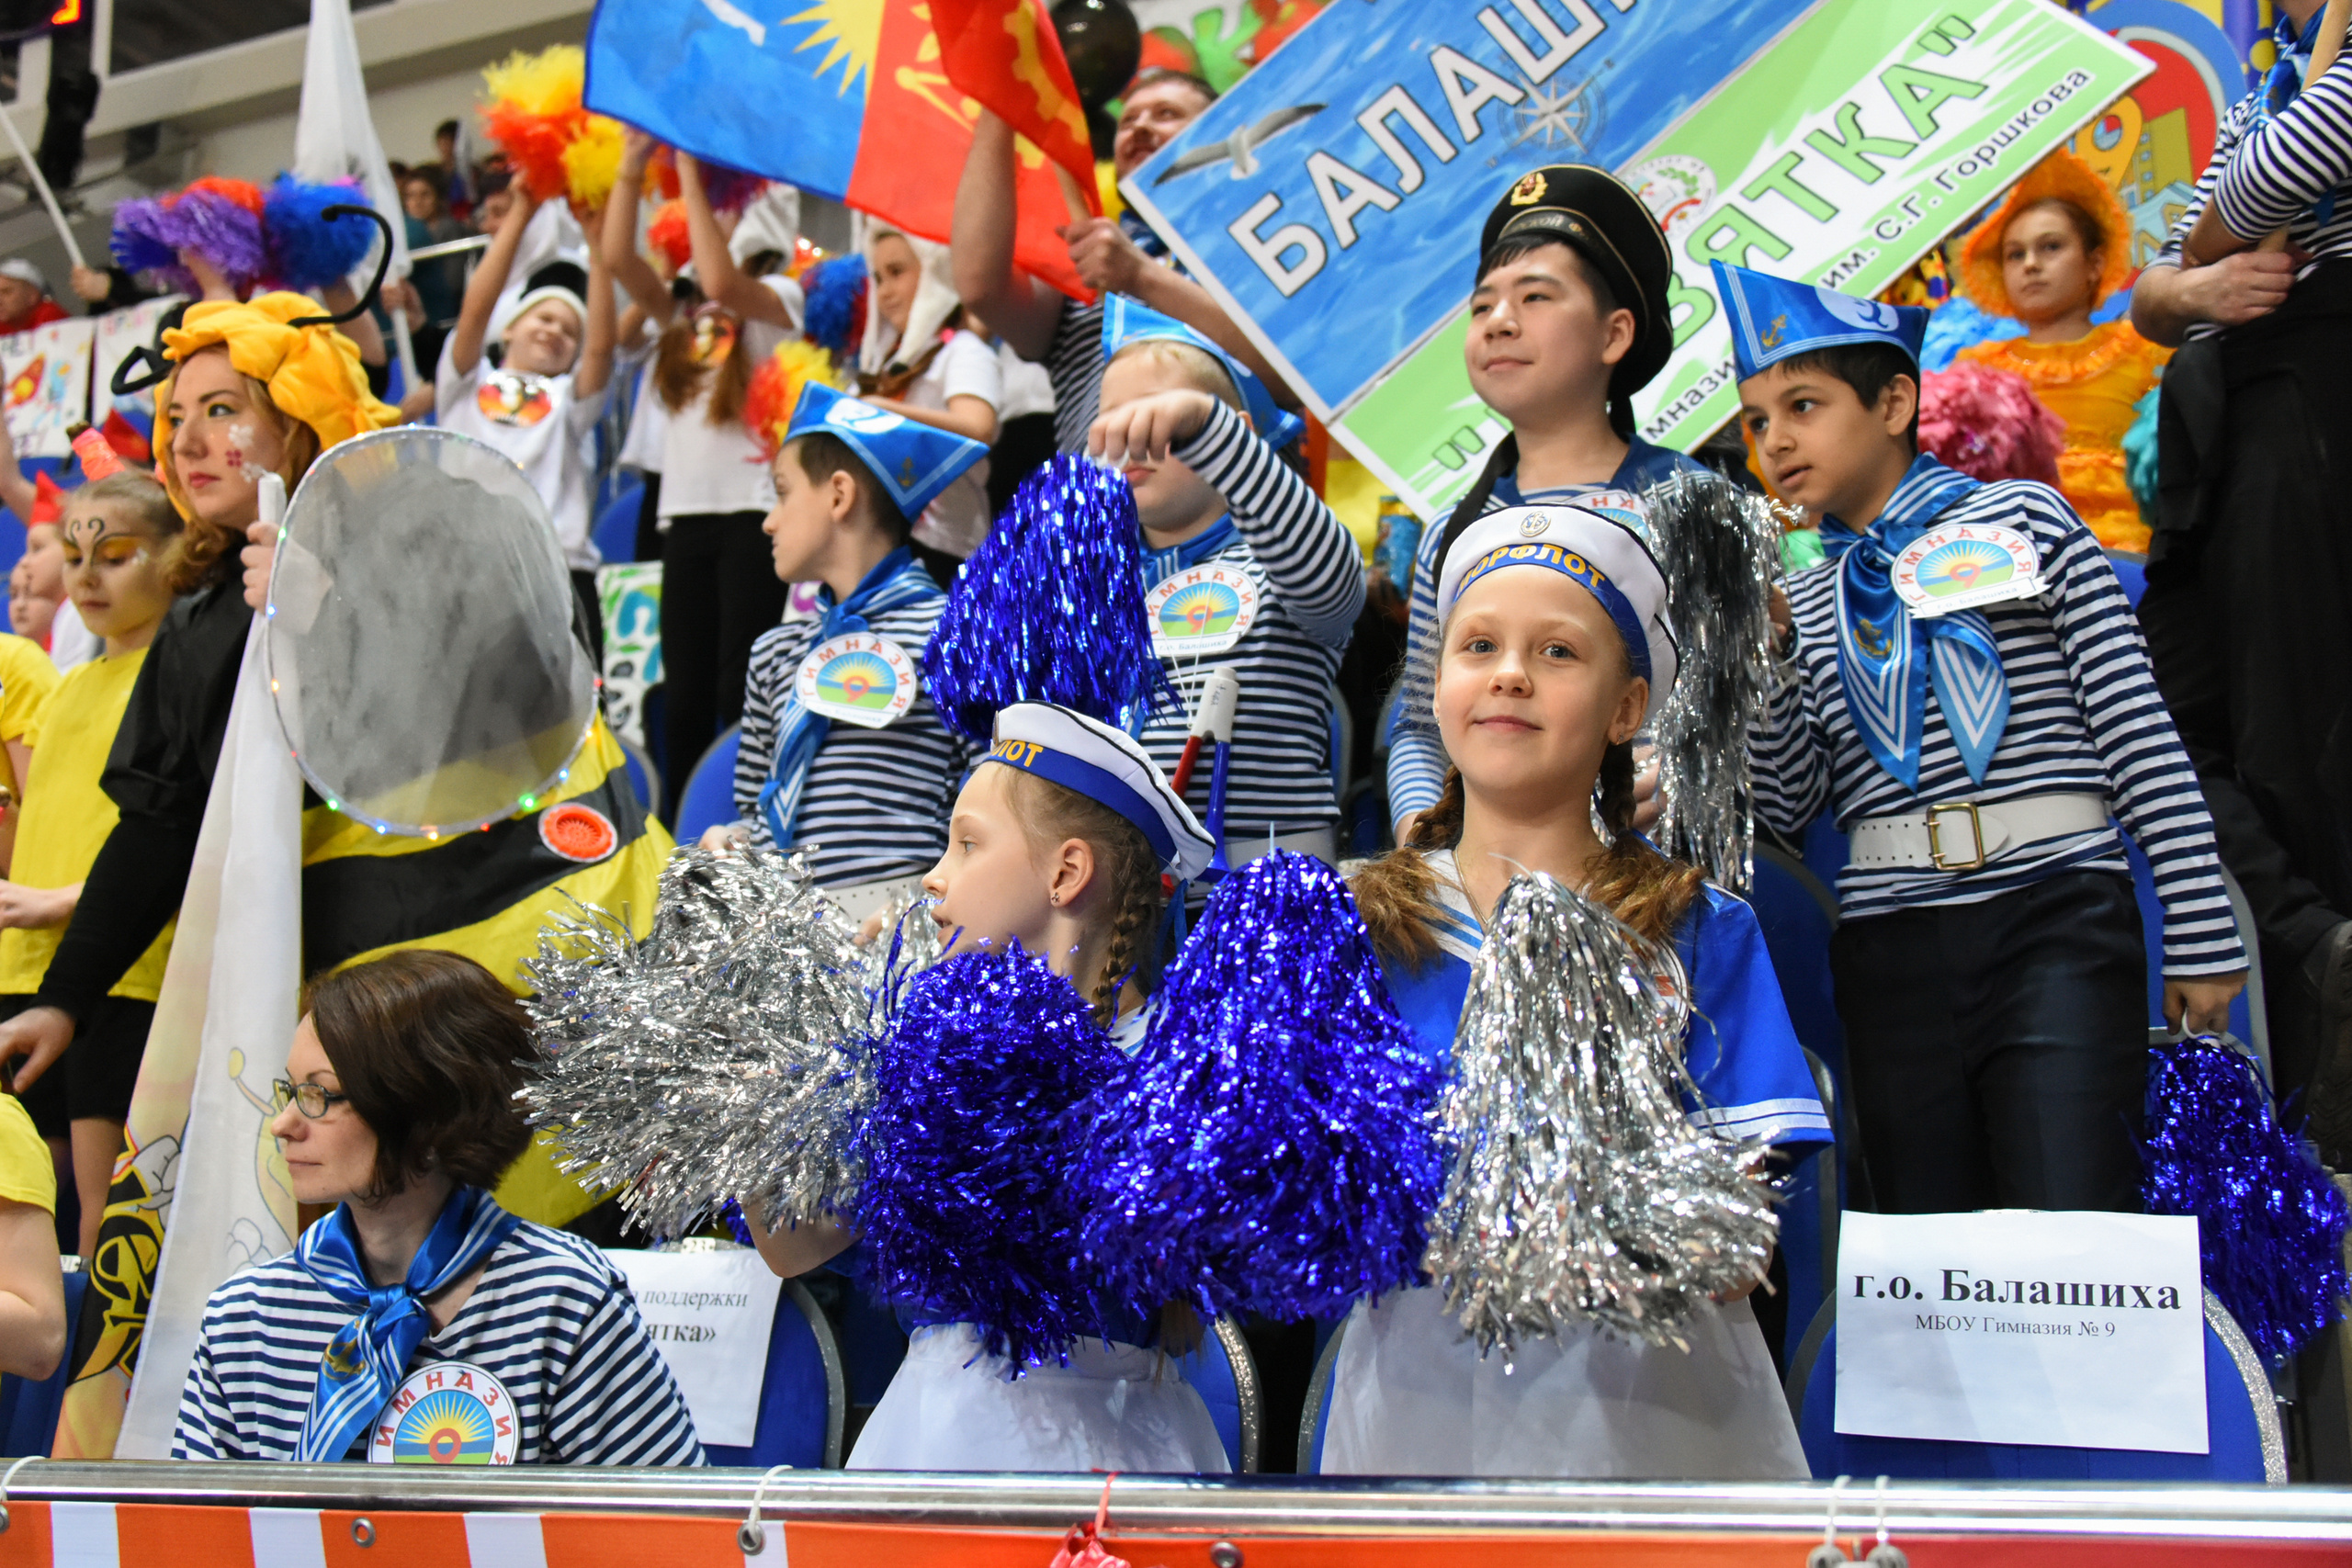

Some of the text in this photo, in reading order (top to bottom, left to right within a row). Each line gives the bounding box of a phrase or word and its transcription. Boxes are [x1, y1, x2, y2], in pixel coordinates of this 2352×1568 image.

[1227, 0, 1637, 299] БАЛАШ
[1644, 359, 1738, 438] мнази
[1934, 70, 2090, 191] Горшкова
[1457, 543, 1606, 597] МОРФЛОТ
[1898, 526, 2032, 602] ГИМНАЗИЯ
[1949, 562, 1982, 589] 9
[1186, 604, 1214, 634] 9
[802, 638, 911, 709] ГИМНАЗИЯ
[842, 675, 870, 703] 9
[992, 739, 1045, 768] ЛОТ
[643, 1290, 748, 1311] поддержки
[1853, 1269, 2182, 1310] г.о. Балашиха
[646, 1324, 717, 1343] ятка»
[1915, 1314, 1977, 1331] МБОУ
[1983, 1316, 2073, 1336] Гимназия
[2104, 1322, 2116, 1337] 9
[376, 1371, 513, 1465] ИМНАЗИЯ
